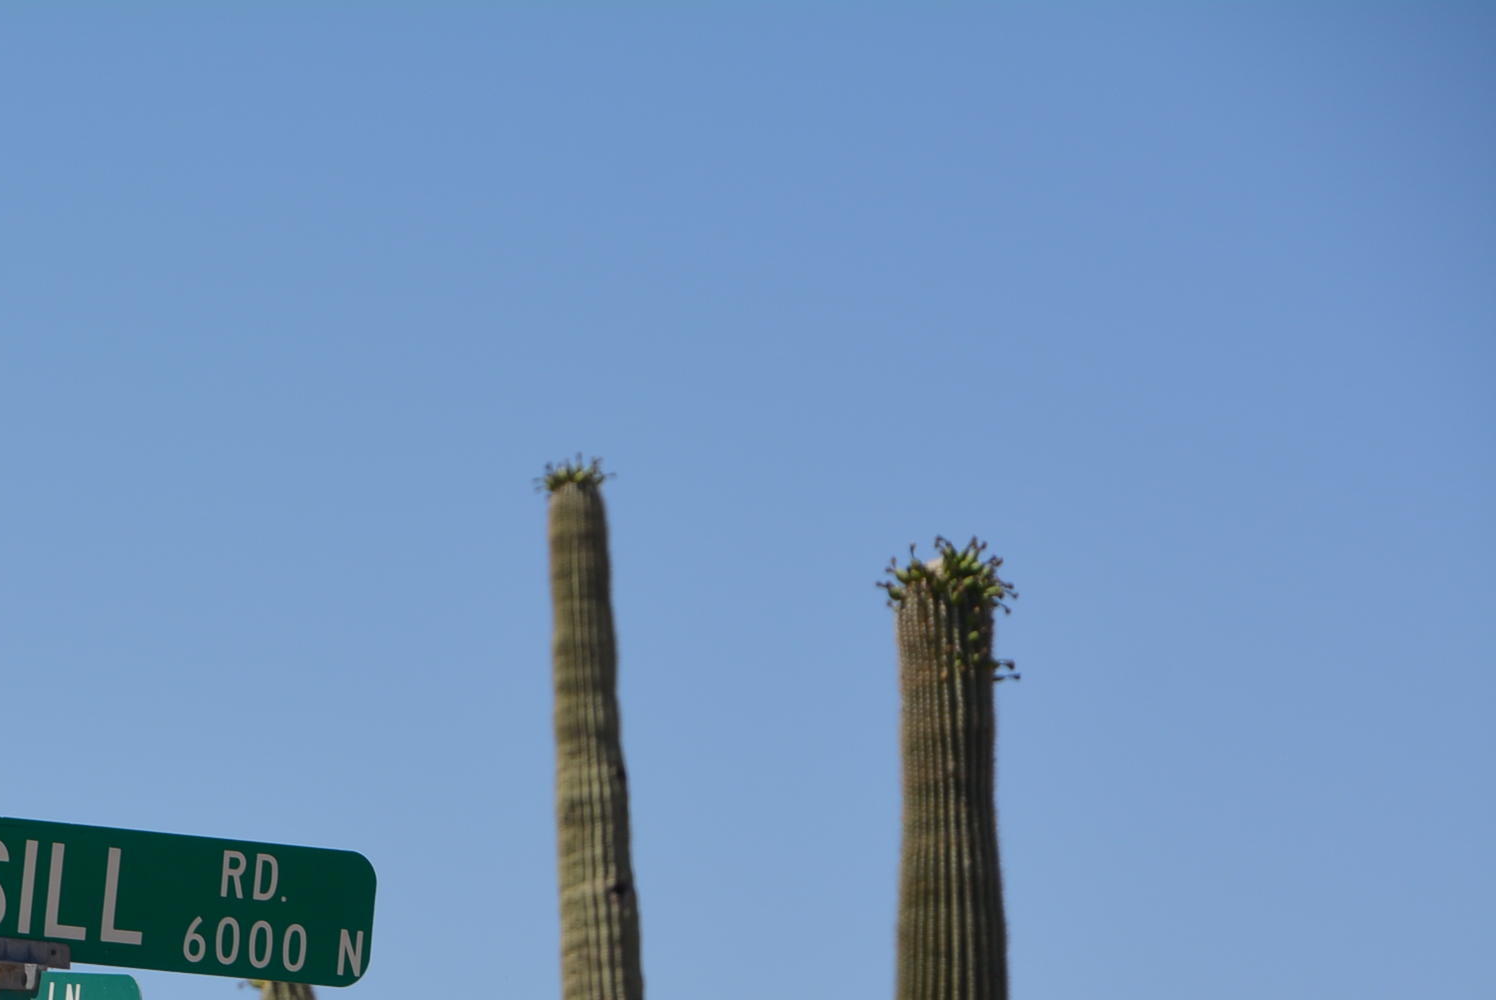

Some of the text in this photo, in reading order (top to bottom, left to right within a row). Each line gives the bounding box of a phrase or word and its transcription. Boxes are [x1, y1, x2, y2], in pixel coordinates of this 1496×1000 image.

[220, 850, 288, 902] RD.
[182, 916, 364, 978] 6000 N
